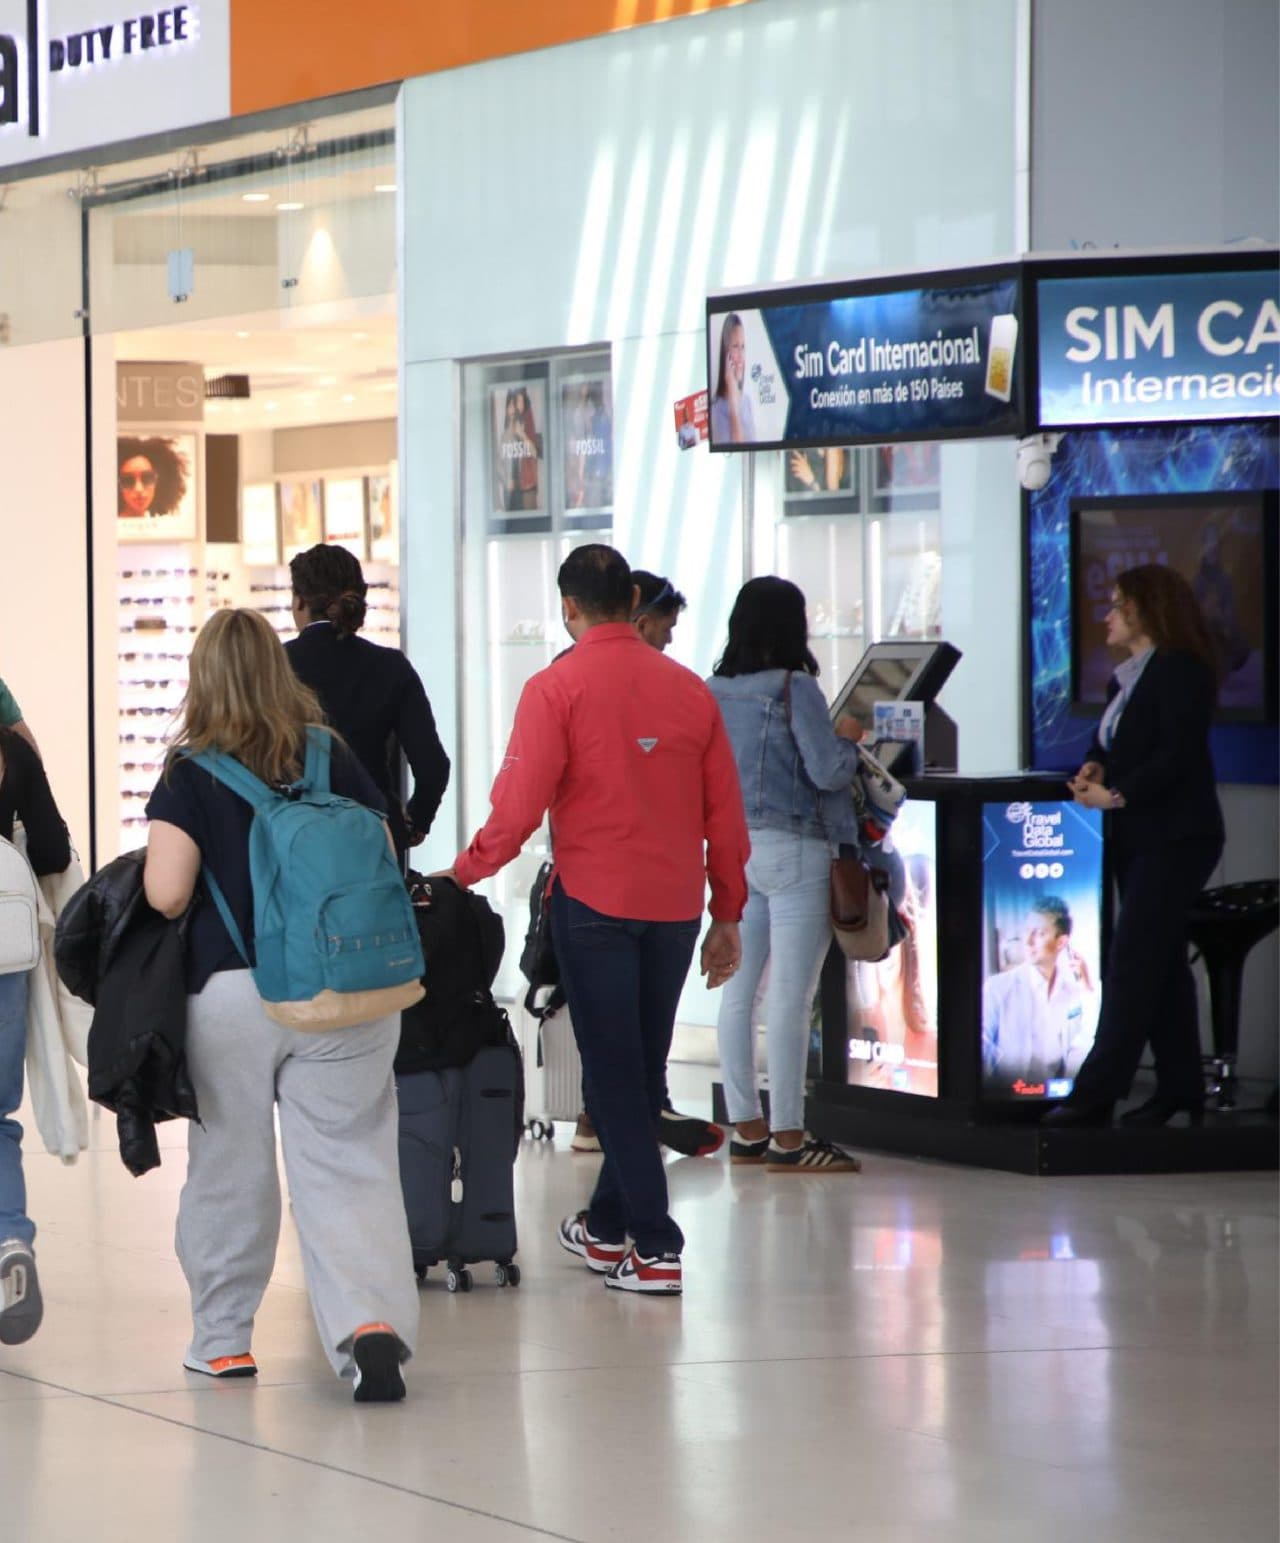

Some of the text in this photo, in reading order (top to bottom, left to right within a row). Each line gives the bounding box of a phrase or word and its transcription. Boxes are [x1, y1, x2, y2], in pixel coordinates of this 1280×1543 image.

[49, 26, 114, 72] DUTY
[123, 5, 188, 54] FREE
[1065, 303, 1175, 363] SIM
[794, 327, 981, 379] Sim Card Internacional
[811, 377, 963, 409] Conexión en más de 150 Países
[1081, 363, 1280, 406] Internaci
[502, 441, 531, 458] FOSSIL
[576, 439, 605, 456] FOSSIL
[1024, 811, 1061, 825] Travel
[1024, 824, 1053, 836] Data
[1024, 833, 1063, 848] Global
